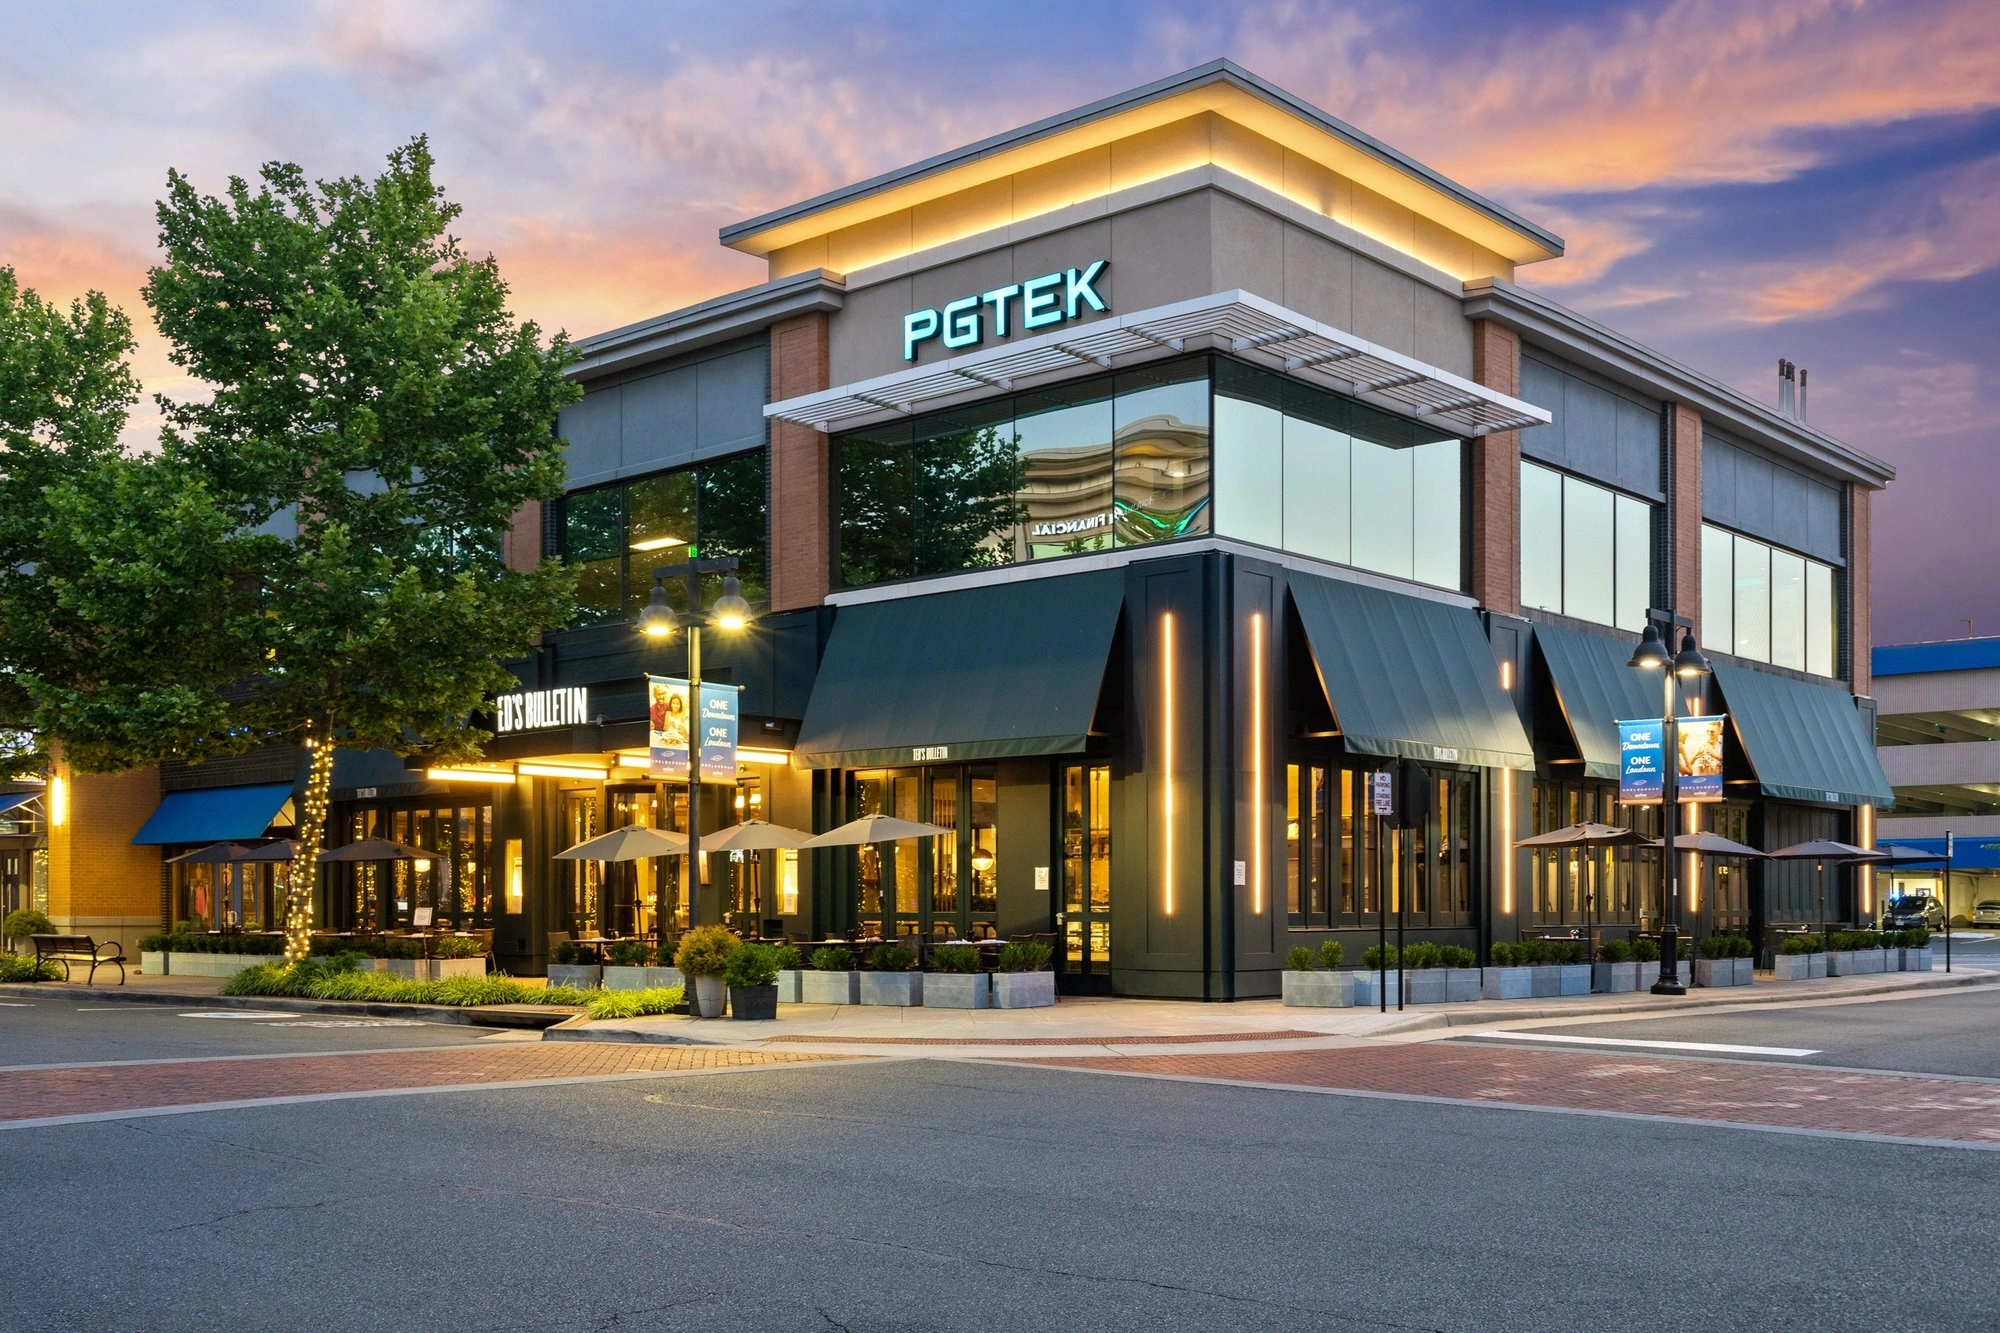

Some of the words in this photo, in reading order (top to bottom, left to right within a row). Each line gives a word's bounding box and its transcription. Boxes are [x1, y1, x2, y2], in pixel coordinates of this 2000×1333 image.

[904, 259, 1110, 361] PGTEK
[497, 693, 523, 732] ED'S
[525, 687, 587, 728] BULLETIN
[709, 700, 728, 710] ONE
[709, 727, 728, 738] ONE
[1630, 732, 1651, 741] ONE
[1630, 756, 1651, 765] ONE
